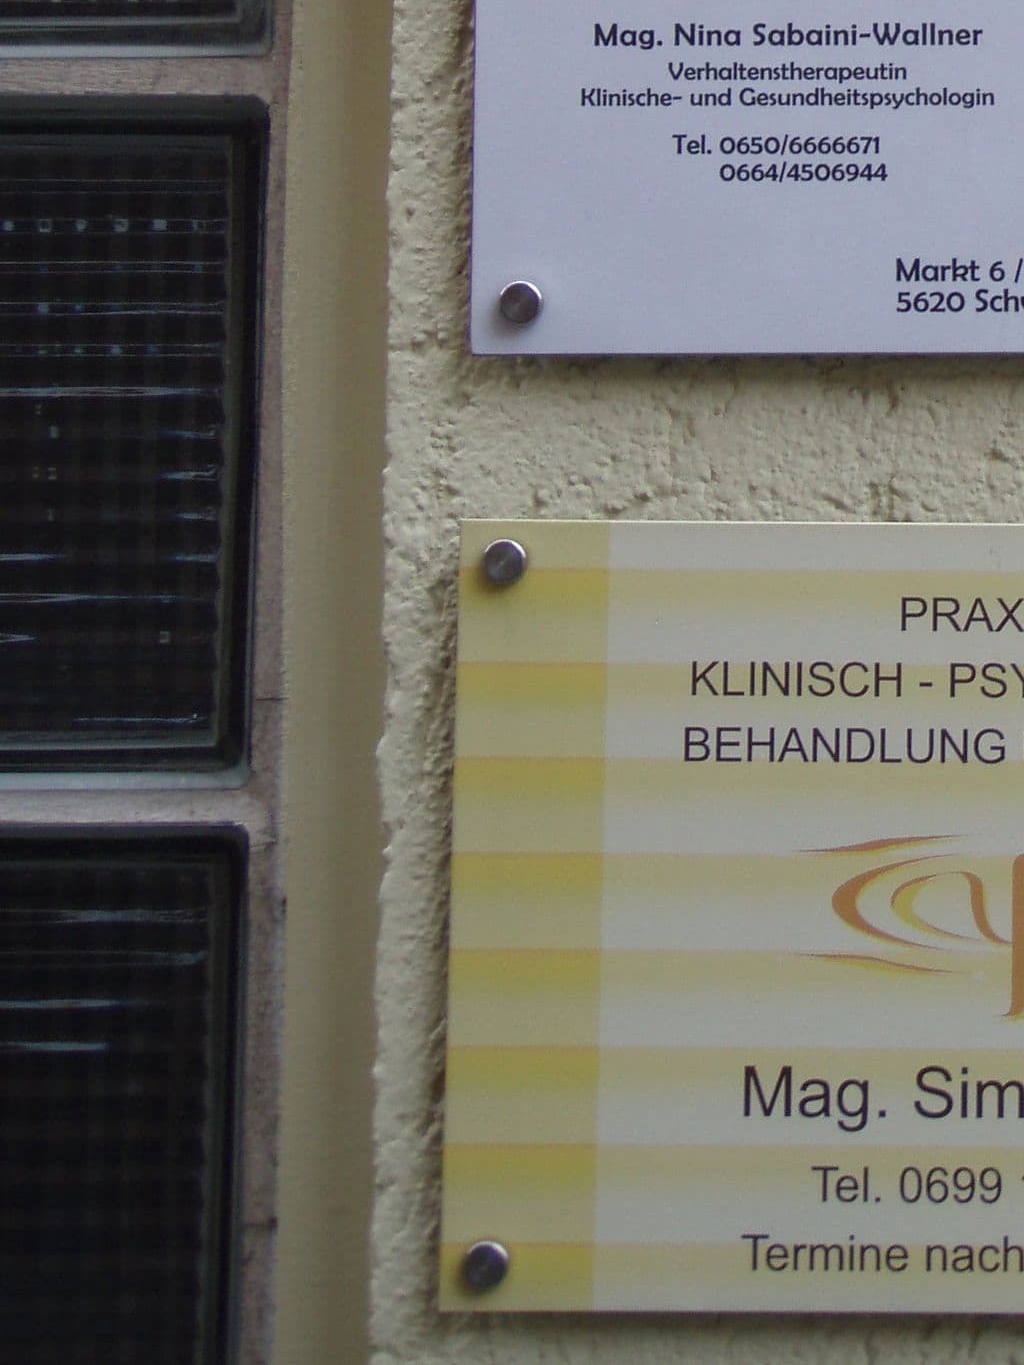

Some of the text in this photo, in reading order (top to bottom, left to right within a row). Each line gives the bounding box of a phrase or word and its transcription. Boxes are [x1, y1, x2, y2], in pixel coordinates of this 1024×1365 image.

[595, 23, 983, 50] Mag. Nina Sabaini-Wallner
[669, 62, 906, 83] Verhaltenstherapeutin
[581, 87, 994, 109] Klinische- und Gesundheitspsychologin
[672, 135, 879, 155] Tel. 0650/6666671
[720, 162, 888, 182] 0664/4506944
[896, 258, 980, 281] Markt
[990, 261, 1005, 282] 6
[1015, 258, 1023, 283] /
[897, 292, 965, 312] 5620
[692, 661, 901, 697] KLINISCH
[684, 727, 1005, 764] BEHANDLUNG
[744, 1066, 885, 1132] Mag.
[812, 1167, 880, 1202] Tel.
[900, 1167, 1002, 1203] 0699
[741, 1234, 908, 1272] Termine
[926, 1236, 1024, 1272] nach
